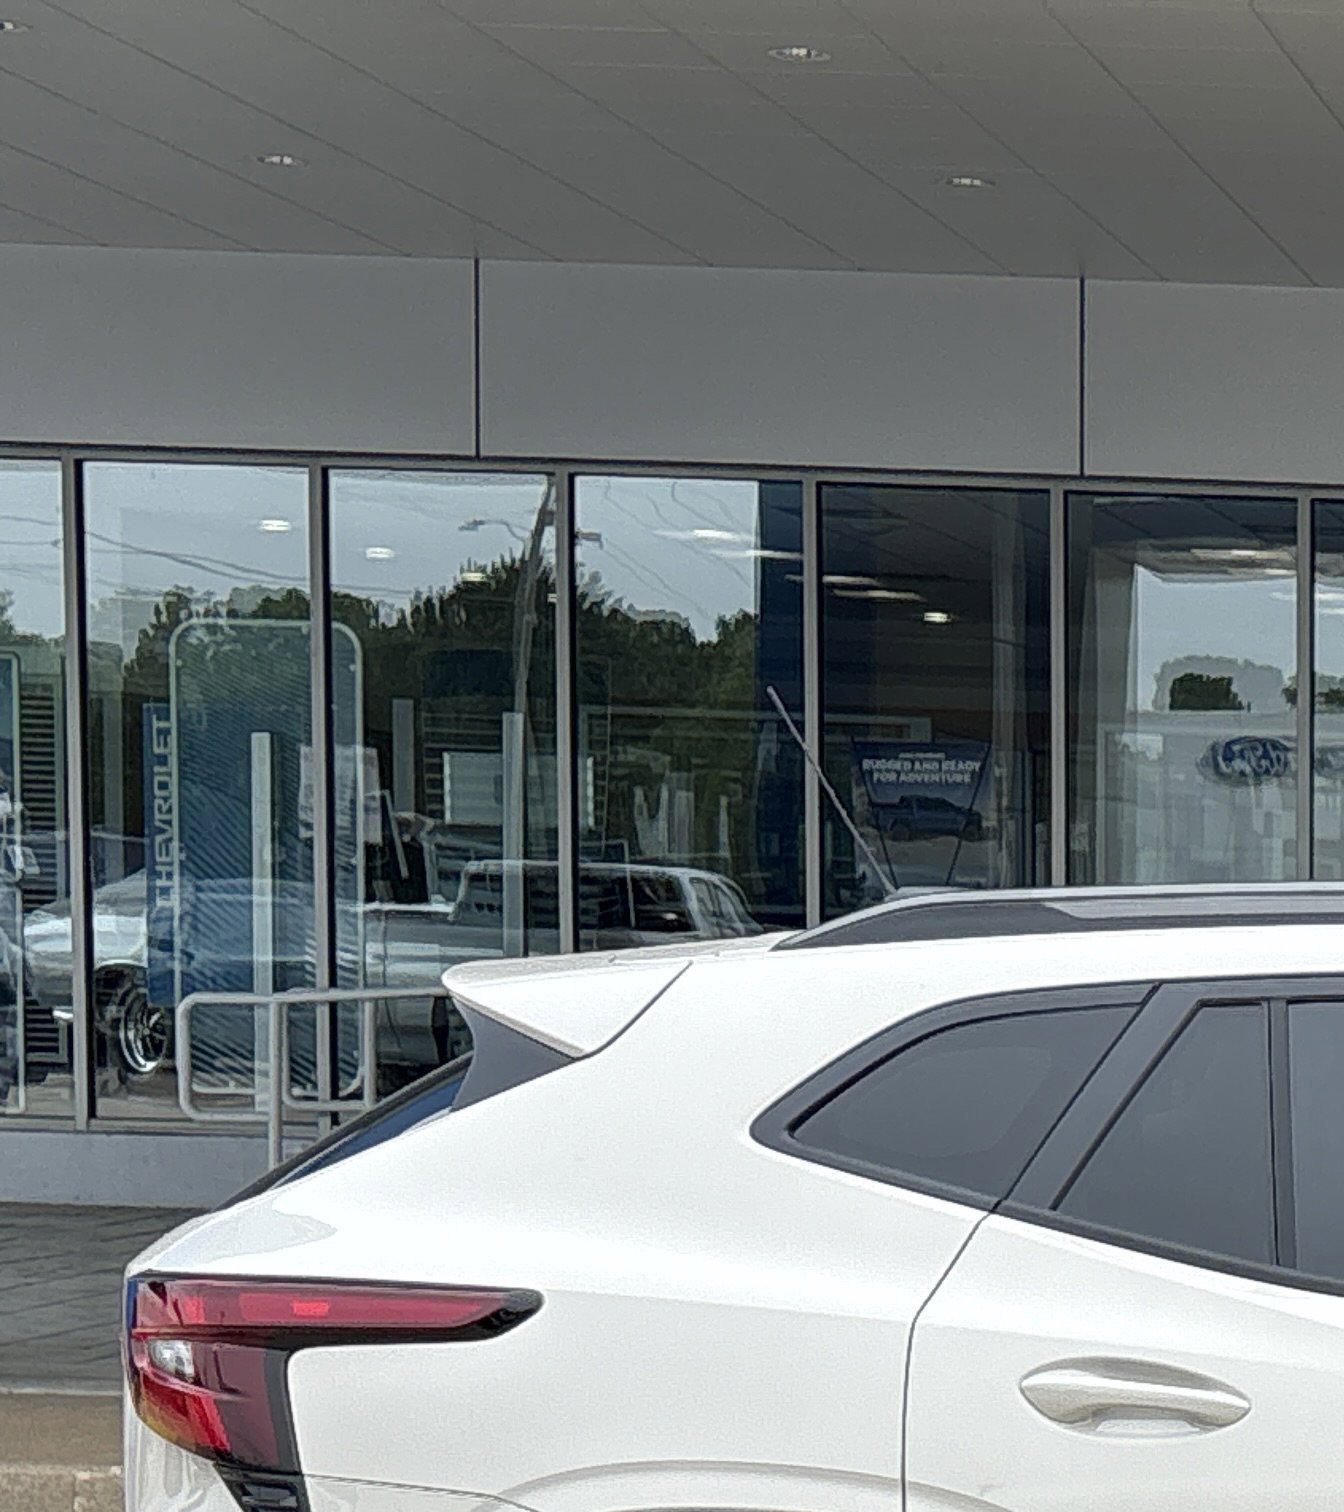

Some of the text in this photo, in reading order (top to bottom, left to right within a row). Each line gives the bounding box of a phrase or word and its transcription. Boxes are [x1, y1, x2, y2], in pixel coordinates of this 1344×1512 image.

[914, 760, 940, 771] AND
[873, 771, 897, 784] FOR
[152, 713, 173, 907] CHEVROLET
